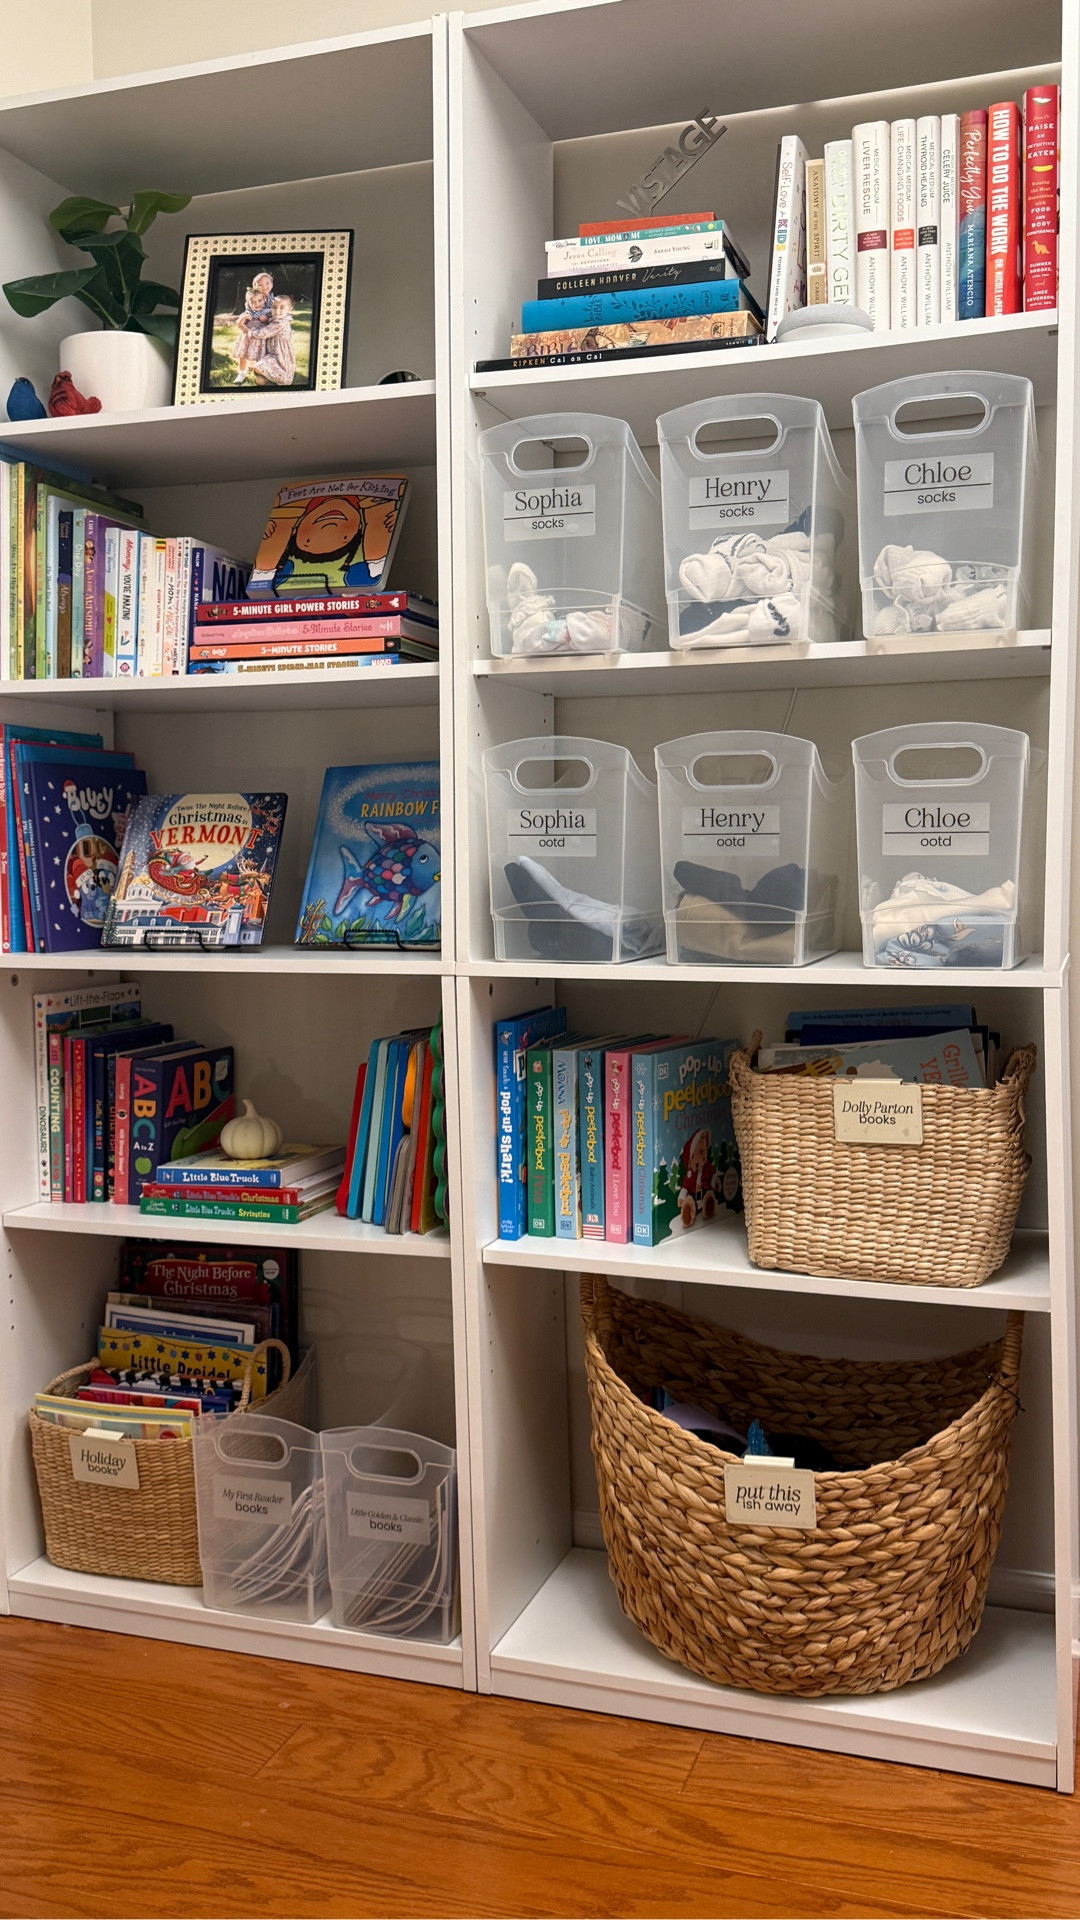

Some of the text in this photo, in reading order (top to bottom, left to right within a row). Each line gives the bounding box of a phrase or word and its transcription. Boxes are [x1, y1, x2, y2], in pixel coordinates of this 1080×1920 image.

[1029, 123, 1054, 132] RAISE
[896, 126, 904, 197] LIFE-CHANGING
[920, 135, 928, 171] THYROID
[1027, 150, 1054, 159] EATER
[862, 140, 871, 215] LIVER RESCUE
[942, 149, 950, 203] CELERY JUICE
[960, 129, 982, 215] Perfectly You
[991, 109, 1010, 255] HOW TO DO THE WORK
[776, 161, 793, 252] Self-Love KIDS
[605, 234, 622, 242] MOM
[564, 248, 616, 260] Jesus Calling
[556, 267, 682, 291] COLLEEN HOOVER Verity
[868, 256, 876, 296] ANTHONY
[994, 258, 1004, 294] DR. NICOLE
[512, 358, 546, 367] RIPKEN
[550, 355, 566, 364] Cal
[586, 352, 602, 360] Cal
[905, 462, 972, 485] Chloe
[287, 481, 397, 500] Feet Are Not for Kicking
[705, 476, 773, 502] Henry
[917, 490, 956, 504] socks
[514, 489, 582, 516] Sophia
[719, 505, 755, 519] socks
[531, 518, 564, 530] socks
[74, 544, 82, 577] One Day
[123, 574, 132, 620] YOU'RE AMAZING
[233, 600, 360, 616] 5-MINUTE GIRL POWER STORIES
[302, 621, 373, 634] 5-Minute Stories
[277, 660, 359, 672] SPIDER-MAN STORIES
[208, 803, 225, 811] Night
[226, 804, 248, 812] Before
[361, 801, 428, 818] RAINBOW
[169, 810, 242, 825] Christmas
[520, 809, 586, 834] Sophia
[700, 808, 765, 832] Henry
[905, 808, 970, 828] Chloe
[150, 824, 264, 850] VERMONT
[538, 838, 565, 847] ootd
[716, 836, 745, 847] ootd
[920, 835, 951, 846] ootd
[50, 1068, 60, 1132] COUNTING
[611, 1078, 620, 1110] pop-up
[636, 1080, 645, 1110] pop-up
[133, 1073, 156, 1140] ABC
[842, 1100, 914, 1116] Dolly Parton
[584, 1072, 597, 1163] pop-up peekaboo!
[859, 1114, 896, 1125] books
[39, 1106, 47, 1153] DINOSAURS
[500, 1091, 514, 1184] pop-up shark!
[635, 1111, 646, 1167] peekaboo!
[133, 1142, 140, 1150] A
[533, 1081, 545, 1204] pop-up peekaboo! Pets
[610, 1112, 622, 1170] peekaboo!
[557, 1108, 572, 1216] pop-up peekaboo!
[182, 1172, 259, 1183] Little Blue Truck
[186, 1190, 280, 1203] Little Blue Truck's Christmas
[185, 1204, 271, 1218] Little Blue Truck's Springtime
[152, 1264, 175, 1279] The
[177, 1267, 210, 1282] Night
[212, 1267, 251, 1280] Before
[163, 1280, 238, 1297] Christmas
[130, 1354, 171, 1374] Little
[80, 1449, 126, 1470] Holiday
[88, 1464, 118, 1475] books
[223, 1489, 283, 1504] My First Reader
[736, 1484, 801, 1503] put this
[235, 1502, 268, 1514] books
[351, 1507, 424, 1524] Little Golden Classic
[743, 1498, 800, 1515] ish away
[369, 1520, 402, 1532] books
